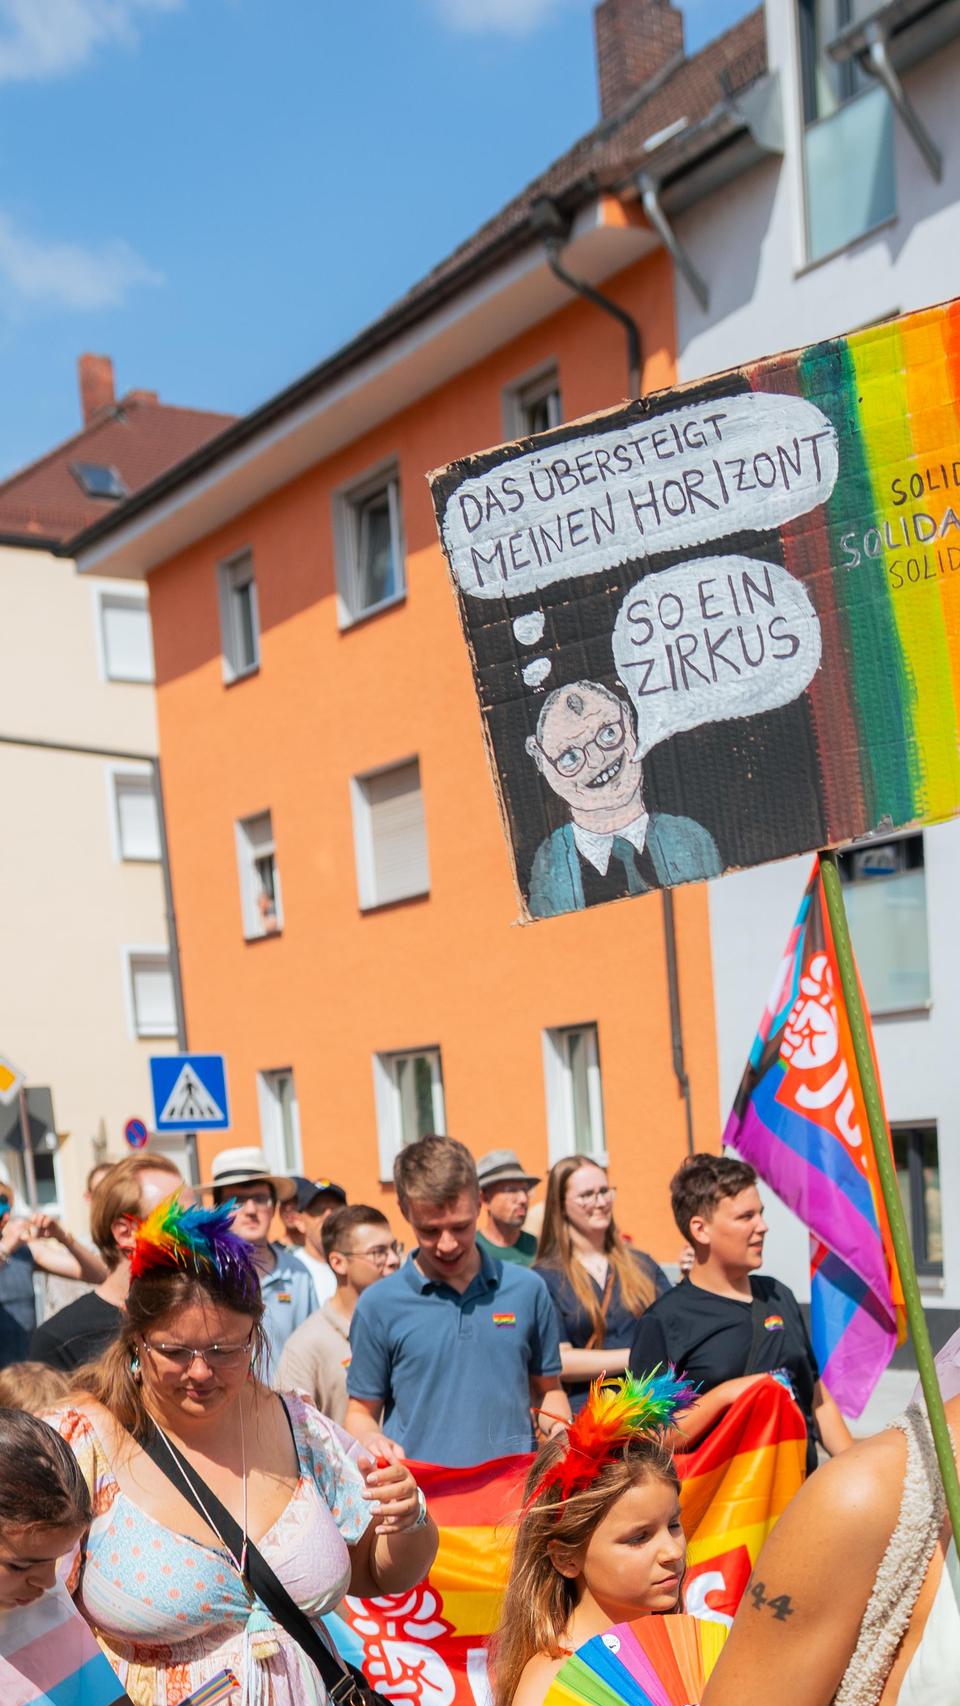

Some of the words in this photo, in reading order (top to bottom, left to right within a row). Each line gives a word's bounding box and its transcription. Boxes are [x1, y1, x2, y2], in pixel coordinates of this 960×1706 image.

[458, 477, 525, 534] DAS
[529, 412, 728, 502] ÜBERSTEIGT
[470, 491, 616, 588] MEINEN
[627, 431, 831, 535] HORIZONT
[620, 616, 800, 696] ZIRKUS
[626, 592, 684, 646] SO
[697, 565, 776, 620] EIN
